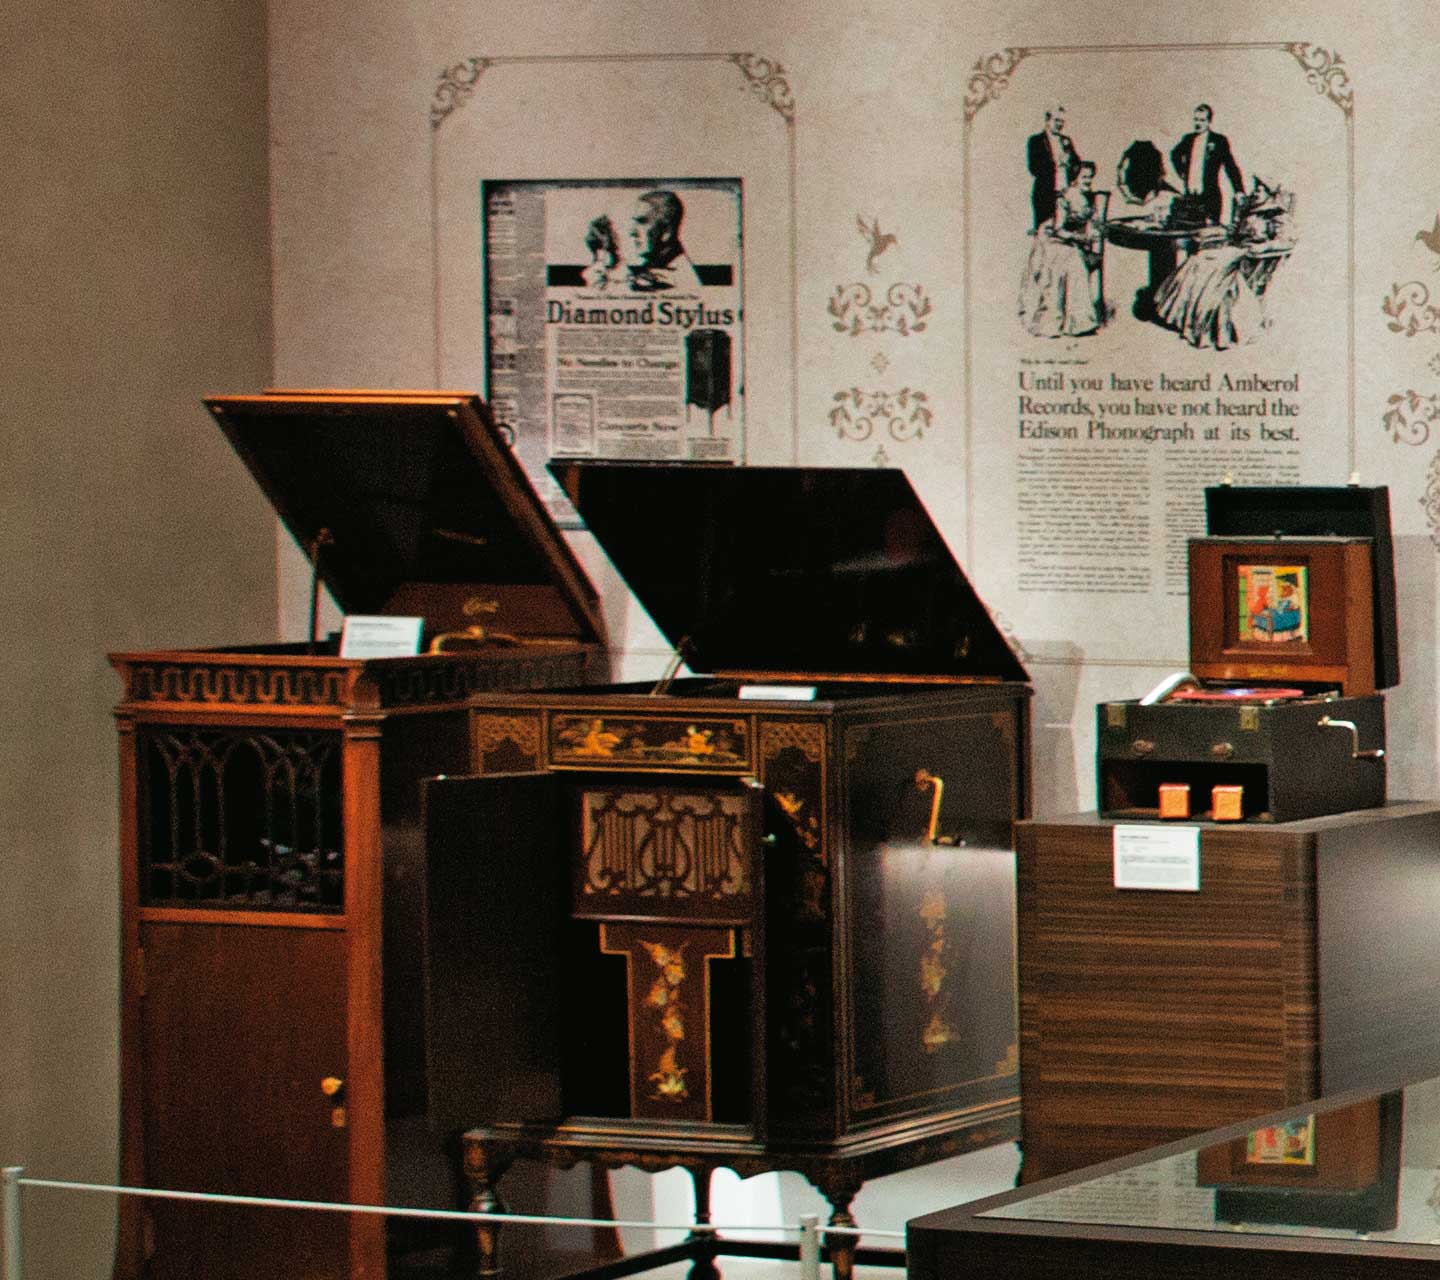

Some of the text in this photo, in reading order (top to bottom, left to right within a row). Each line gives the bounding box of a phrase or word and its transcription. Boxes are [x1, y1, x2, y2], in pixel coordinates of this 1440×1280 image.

[546, 300, 734, 328] Diamond Stylus
[1018, 372, 1299, 394] Until you have heard Amberol
[1018, 395, 1300, 418] Records, you have not heard the
[1018, 420, 1300, 444] Edison Phonograph at its best.
